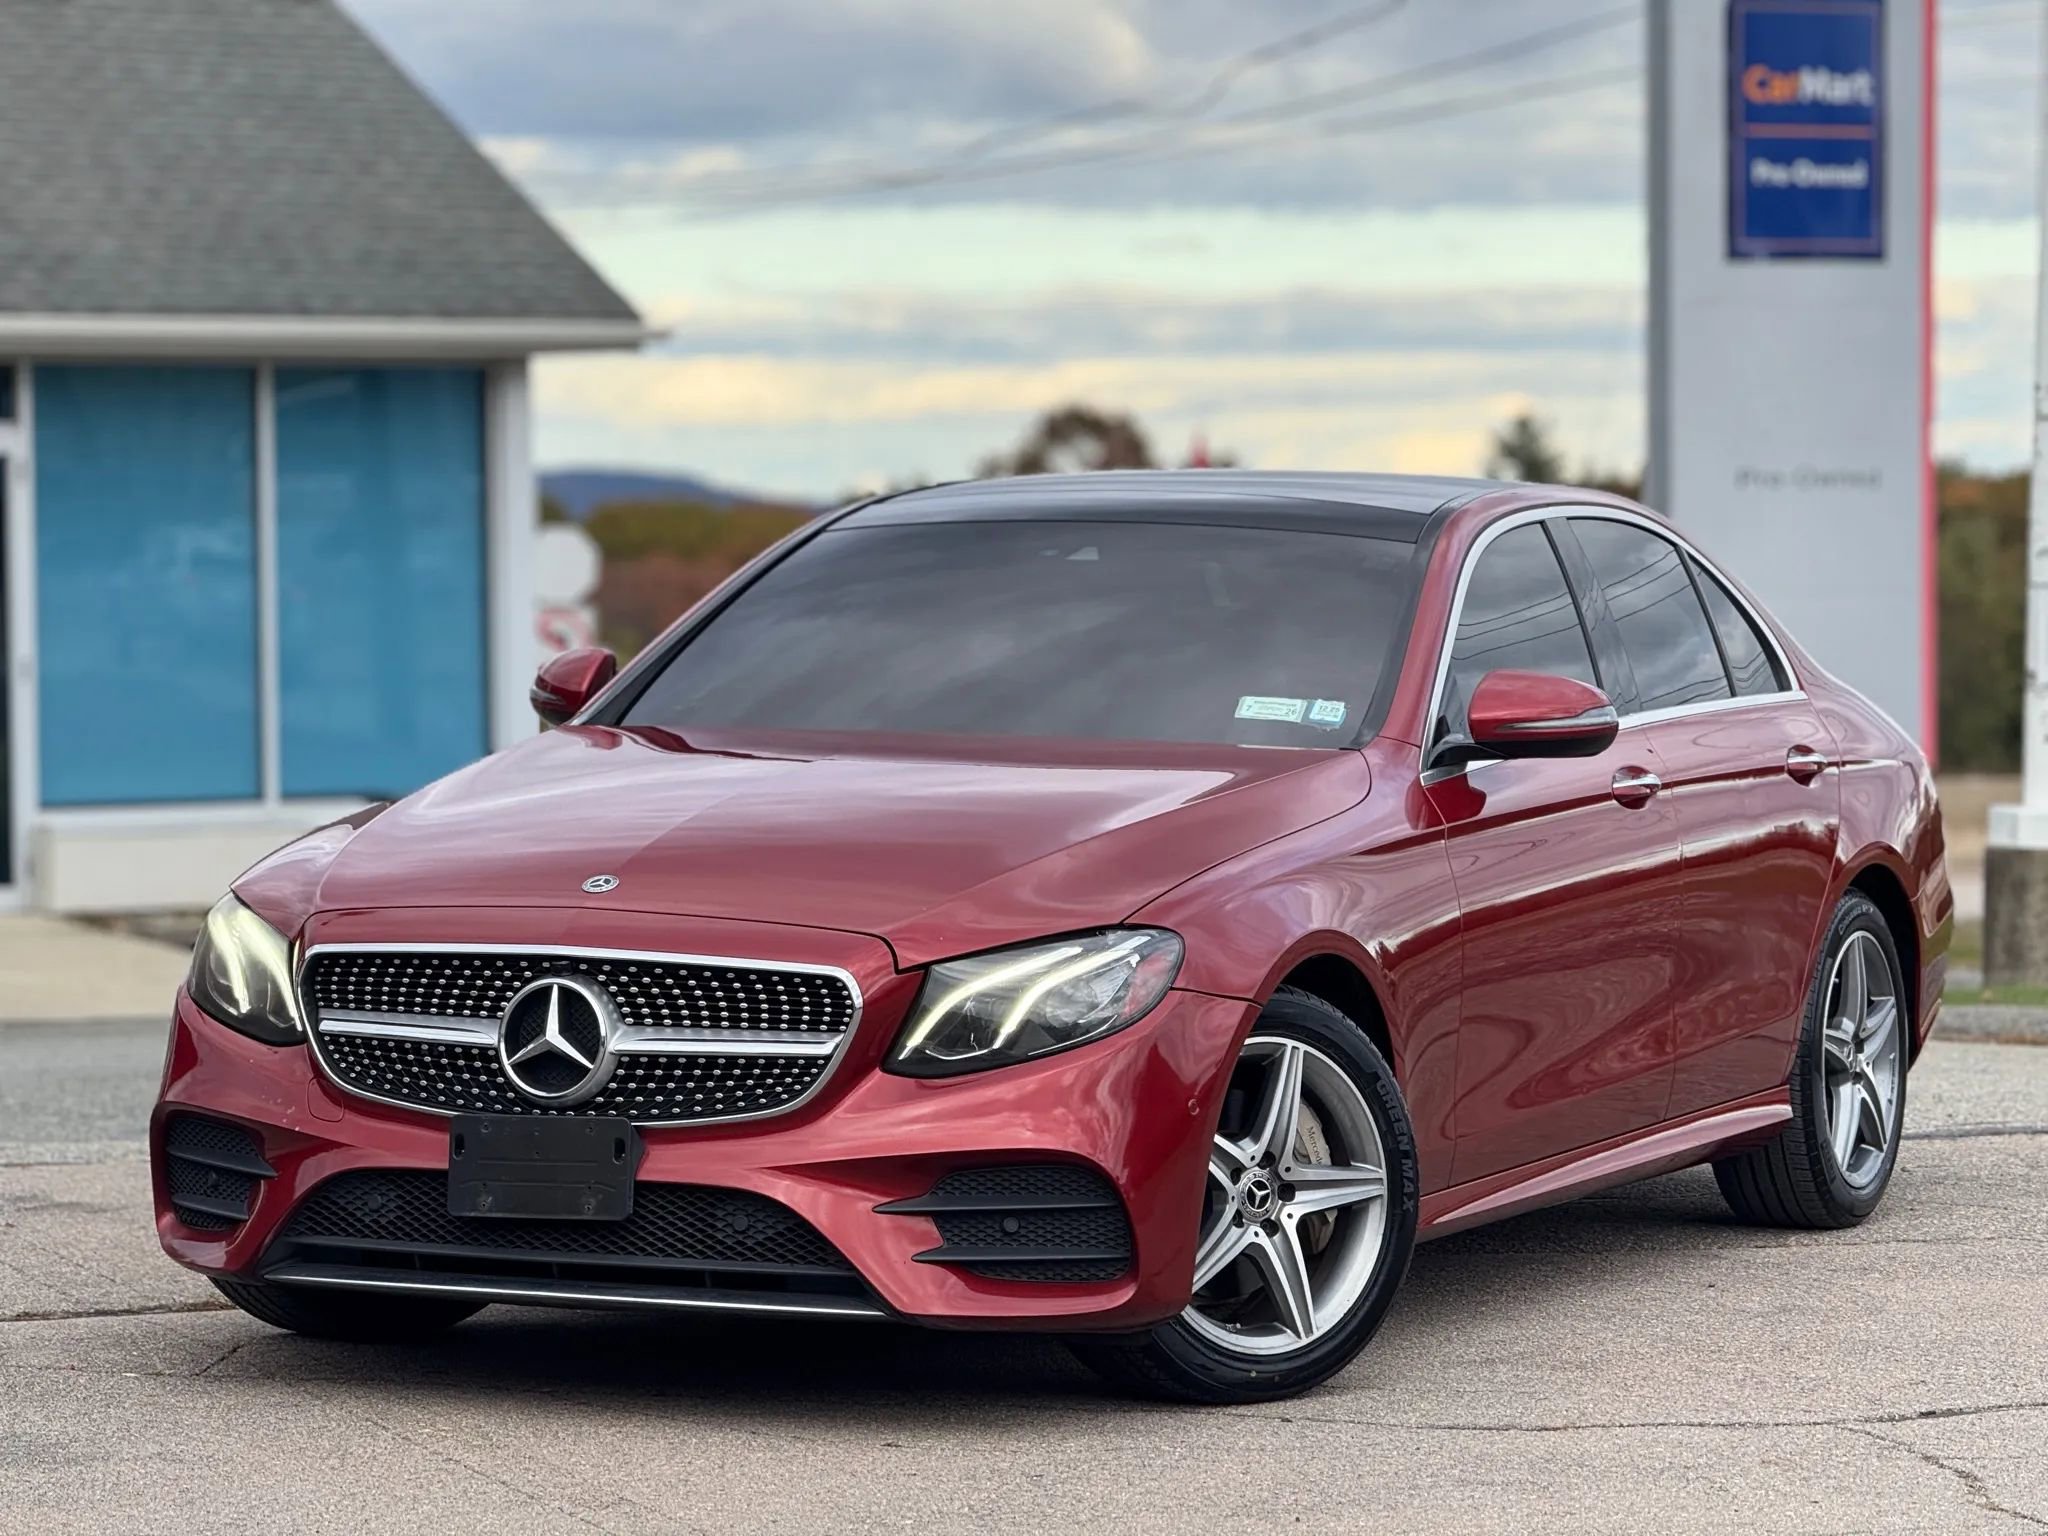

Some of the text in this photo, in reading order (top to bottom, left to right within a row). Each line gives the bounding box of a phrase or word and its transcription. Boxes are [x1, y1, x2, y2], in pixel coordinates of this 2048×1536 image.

[1742, 64, 1873, 106] CarMart
[1376, 1081, 1414, 1212] GREEN MAX
